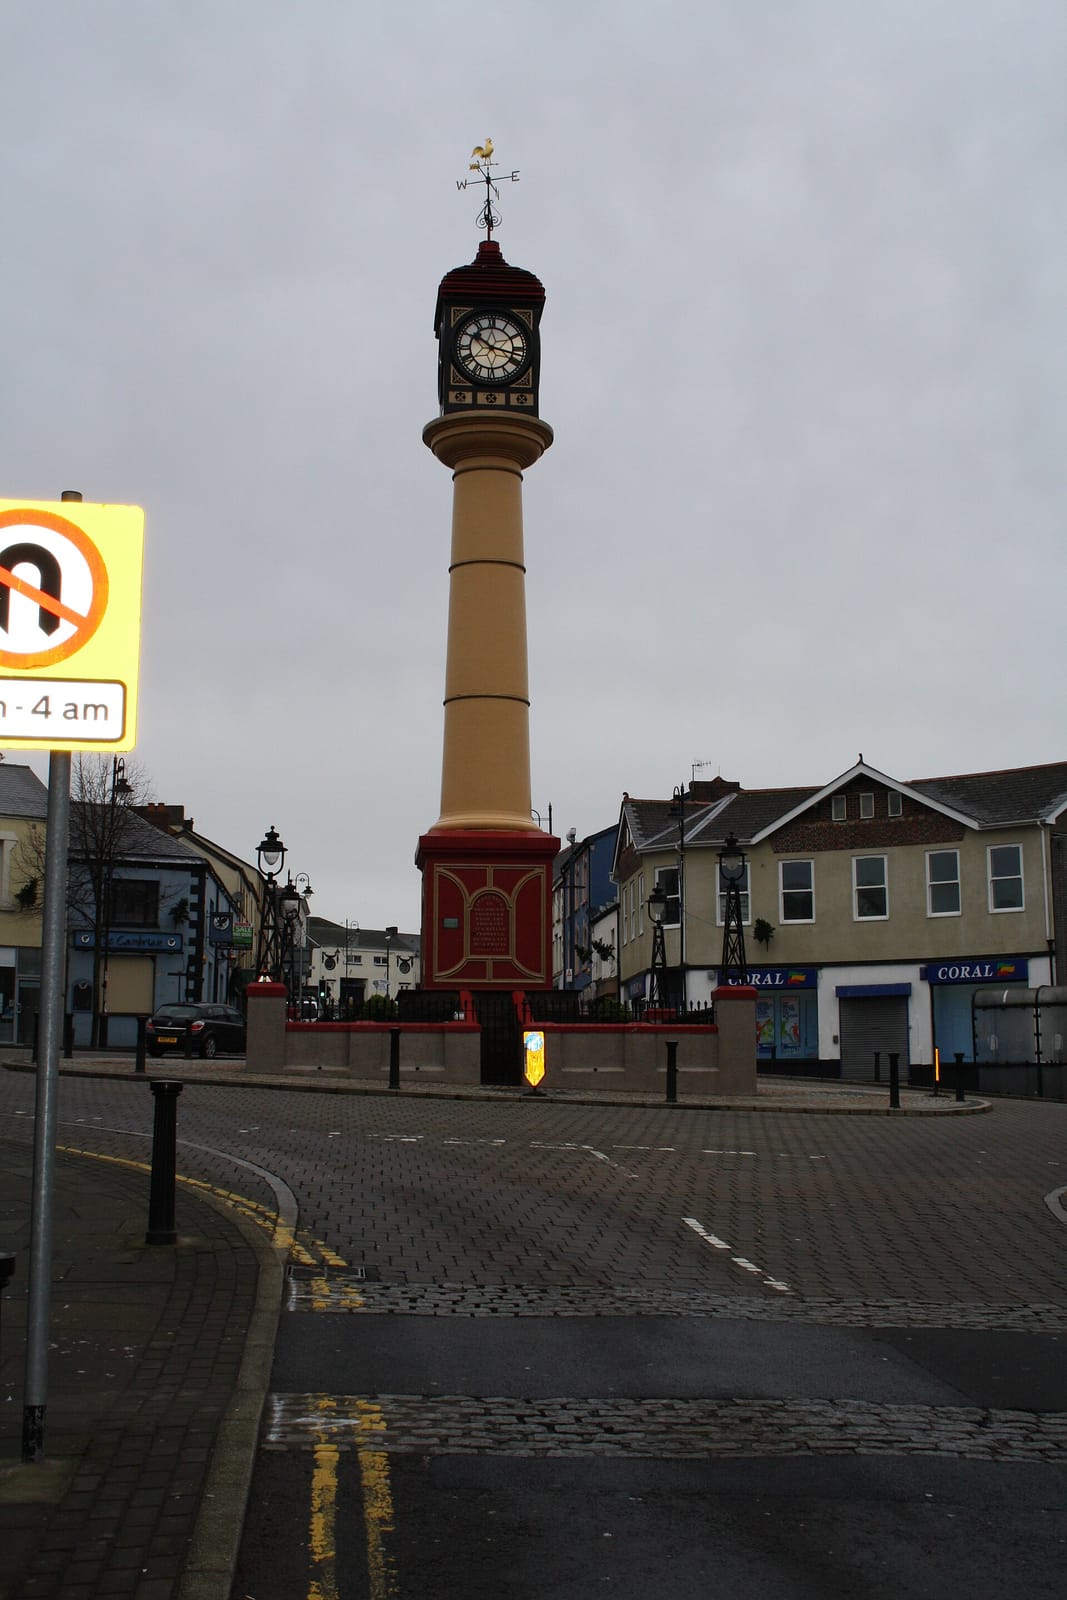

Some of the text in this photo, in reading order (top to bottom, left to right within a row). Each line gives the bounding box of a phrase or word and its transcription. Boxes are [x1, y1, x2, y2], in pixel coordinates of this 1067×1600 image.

[511, 170, 520, 181] E
[31, 695, 52, 719] 4
[938, 965, 993, 979] CORAL
